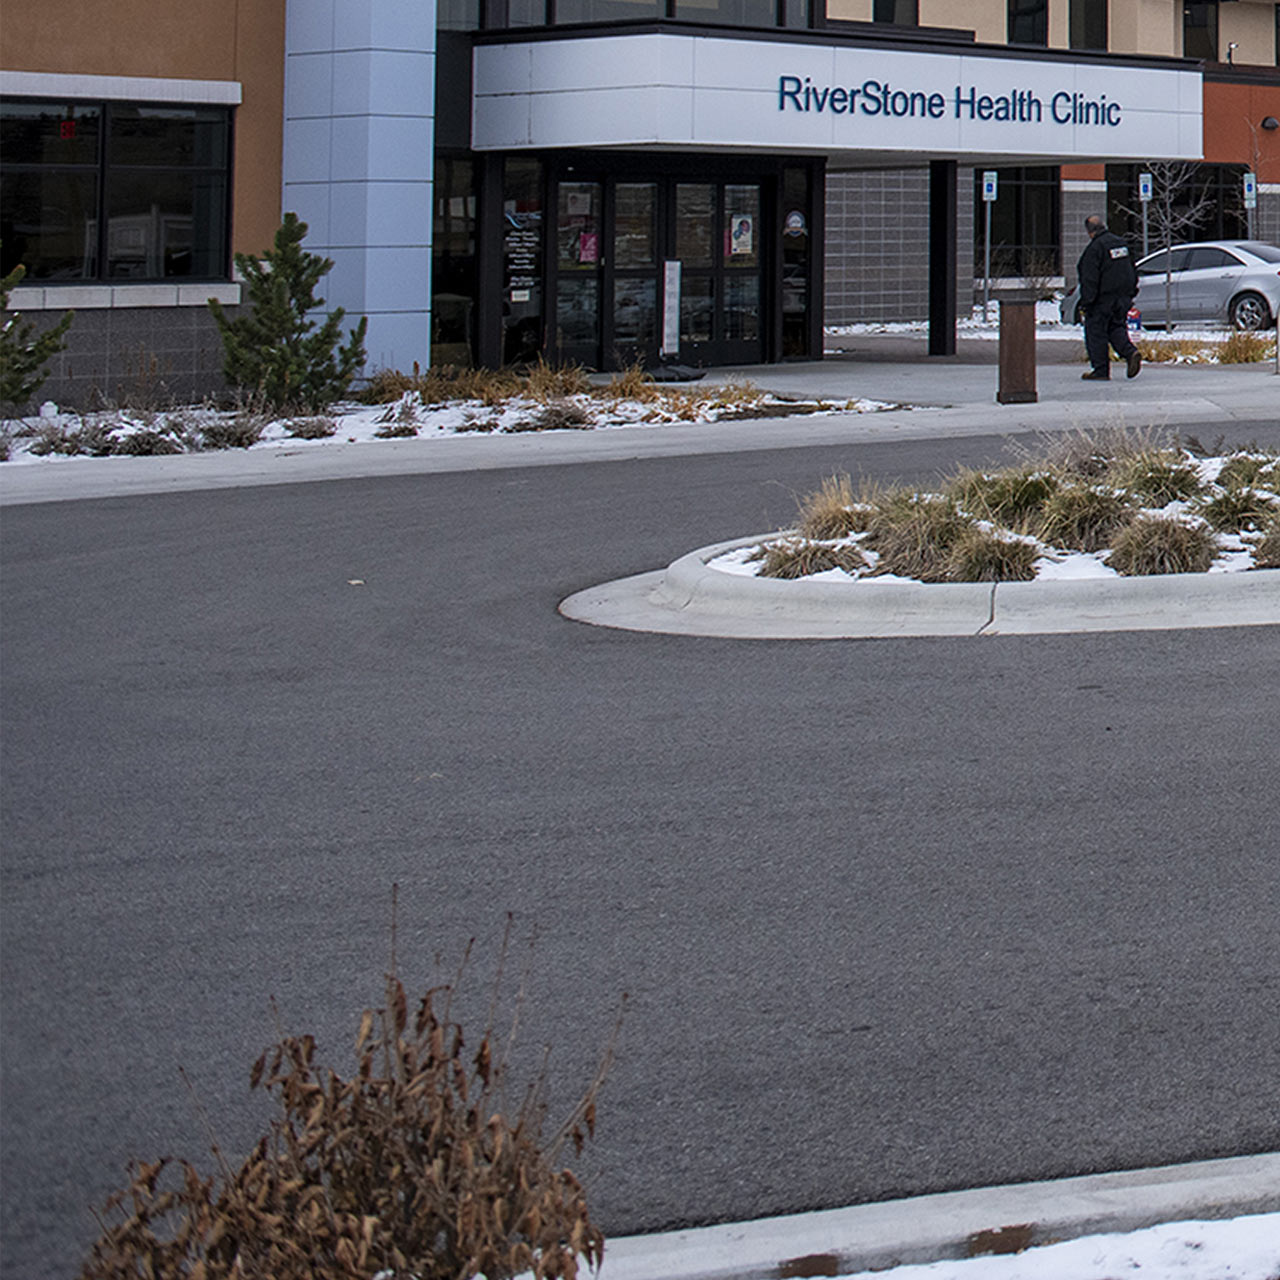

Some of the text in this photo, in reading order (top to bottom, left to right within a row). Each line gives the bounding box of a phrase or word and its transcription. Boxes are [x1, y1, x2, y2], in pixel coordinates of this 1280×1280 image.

[778, 75, 1122, 127] RiverStone Health Clinic
